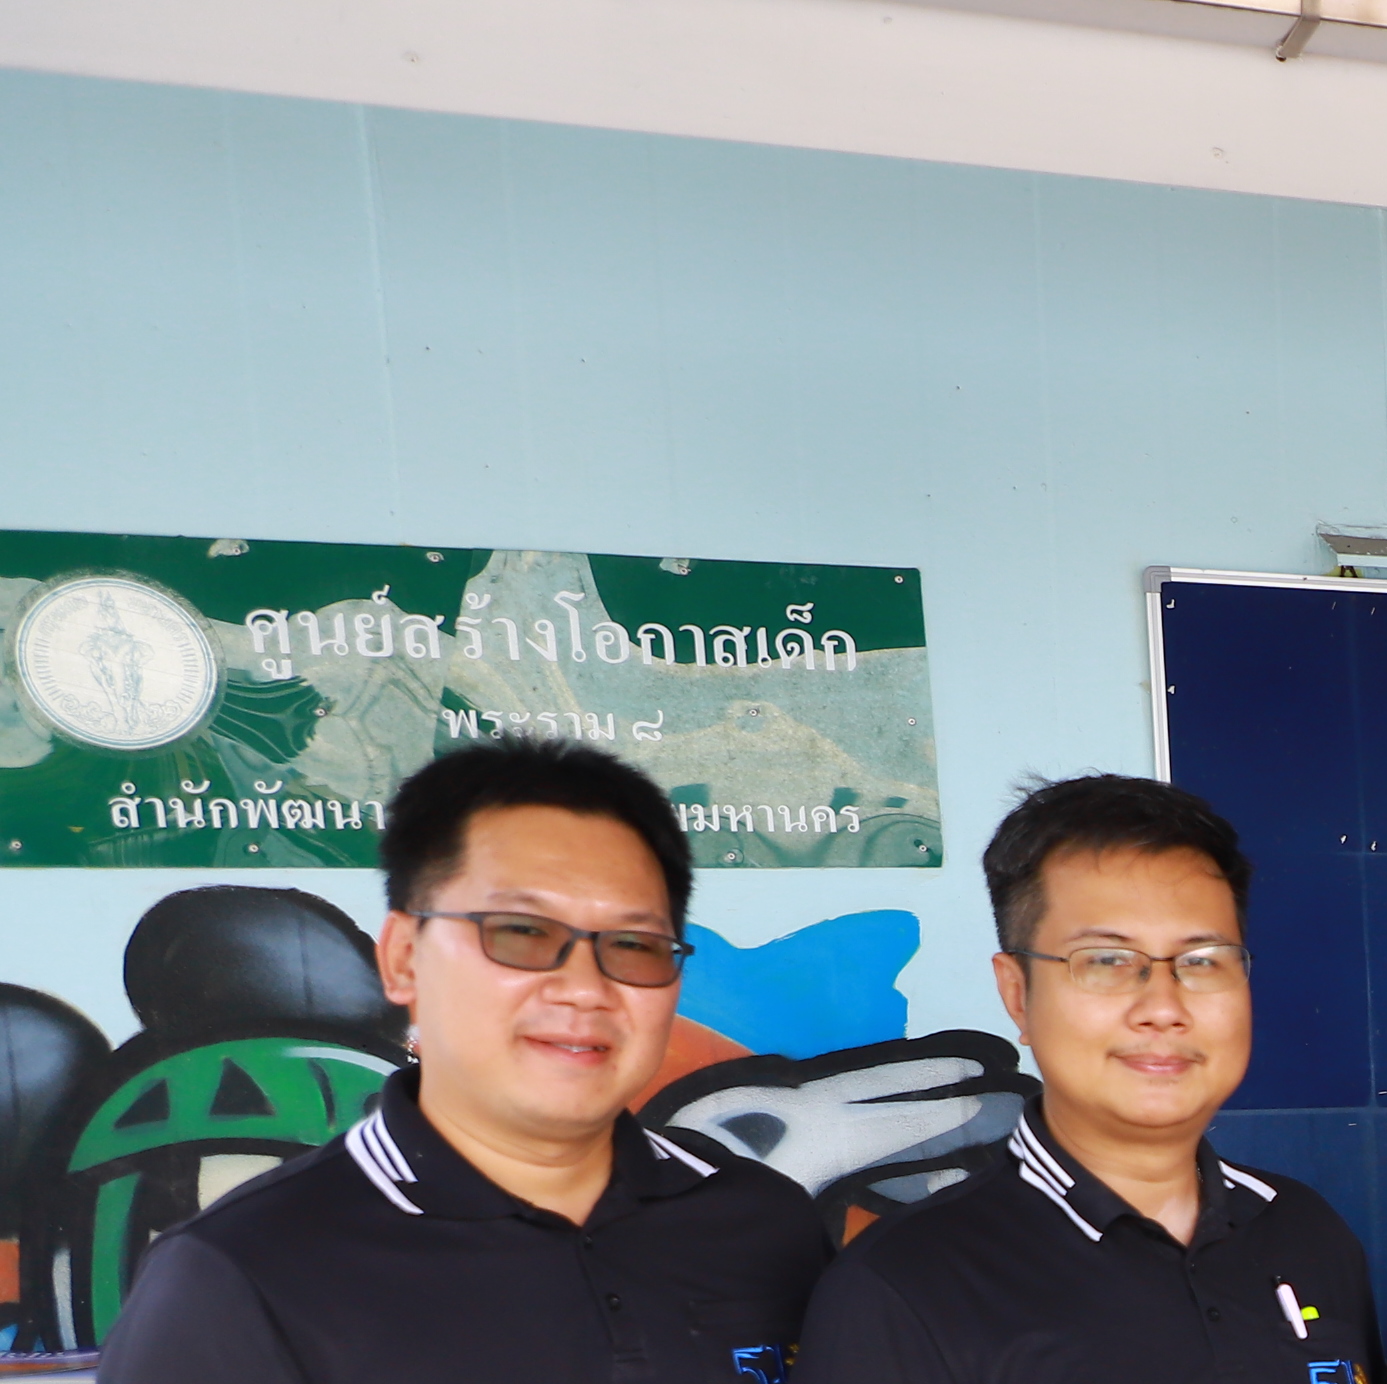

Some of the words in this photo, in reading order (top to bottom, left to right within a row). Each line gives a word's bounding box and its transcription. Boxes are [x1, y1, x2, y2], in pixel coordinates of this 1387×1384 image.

[244, 583, 858, 679] ศูนย์สร้างโอกาสเด็ก
[443, 708, 615, 742] พระราม
[632, 709, 664, 742] ๘
[108, 779, 387, 832] สำนักพัฒนา
